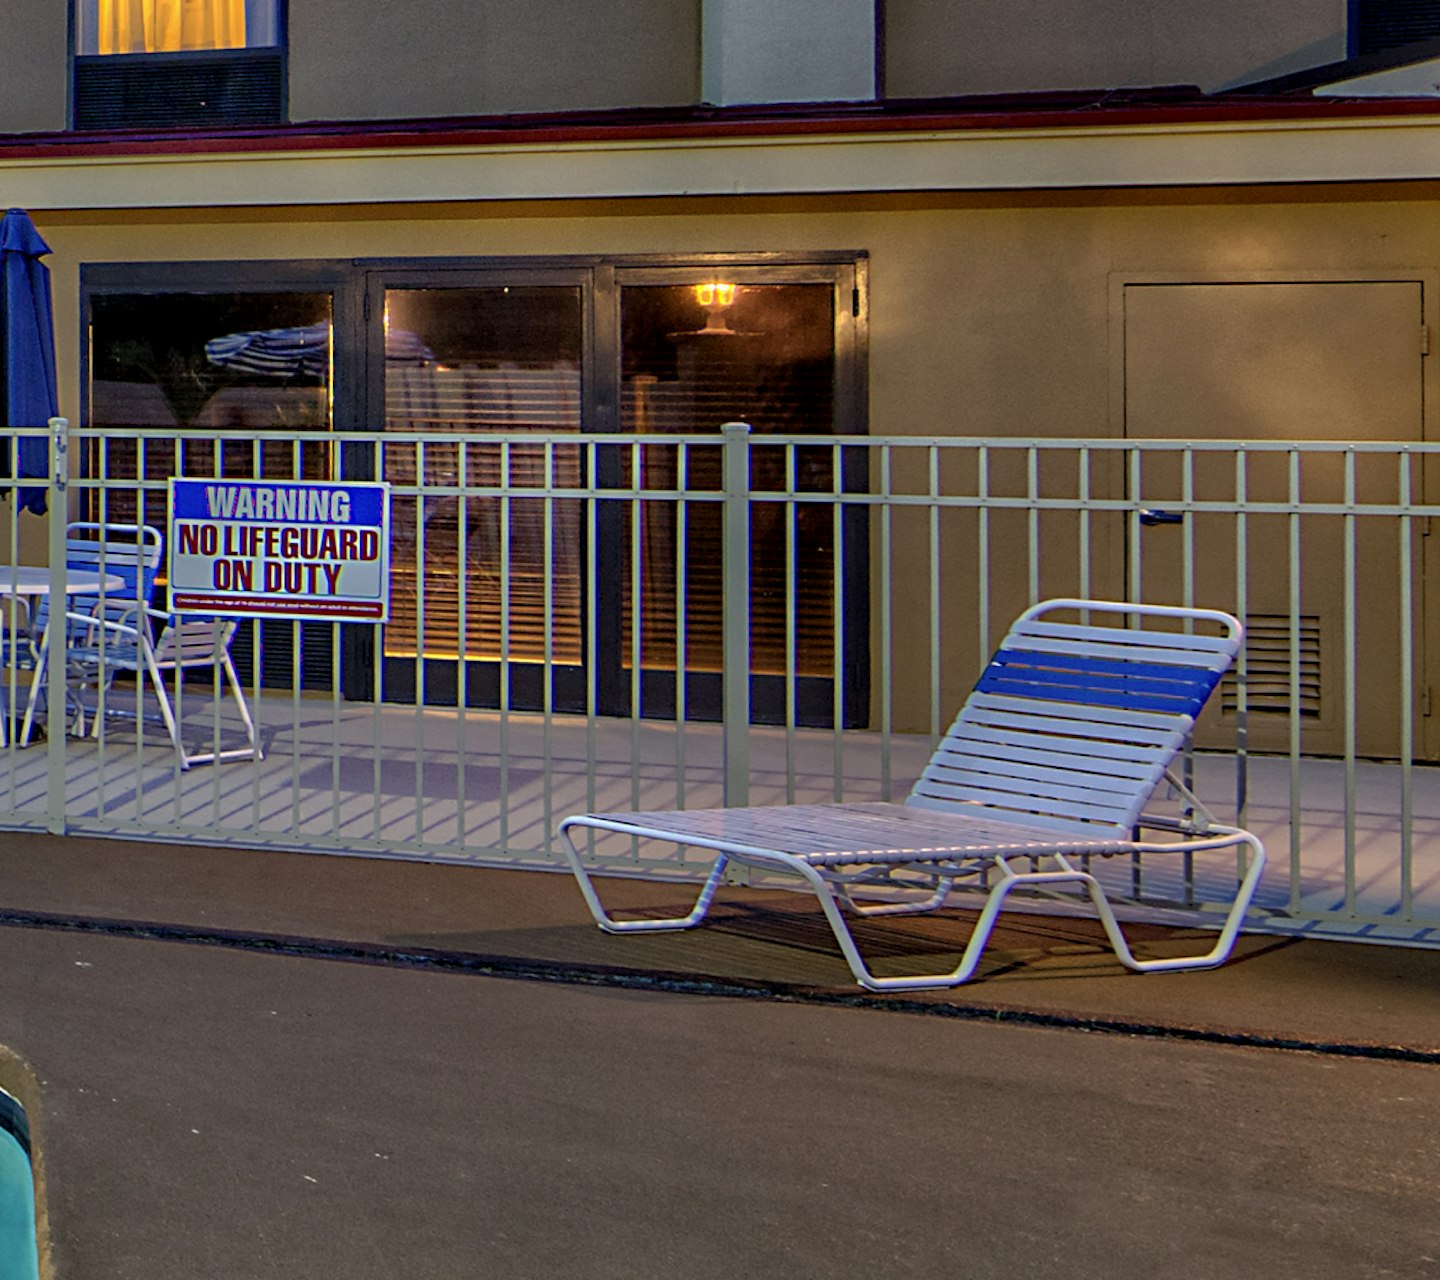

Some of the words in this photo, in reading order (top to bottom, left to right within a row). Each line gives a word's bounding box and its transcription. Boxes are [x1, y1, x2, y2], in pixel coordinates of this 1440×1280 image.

[206, 486, 351, 522] WARNING
[179, 524, 217, 555] NO
[223, 526, 378, 561] LIFEGUARD
[213, 559, 253, 591] ON
[264, 561, 342, 595] DUTY
